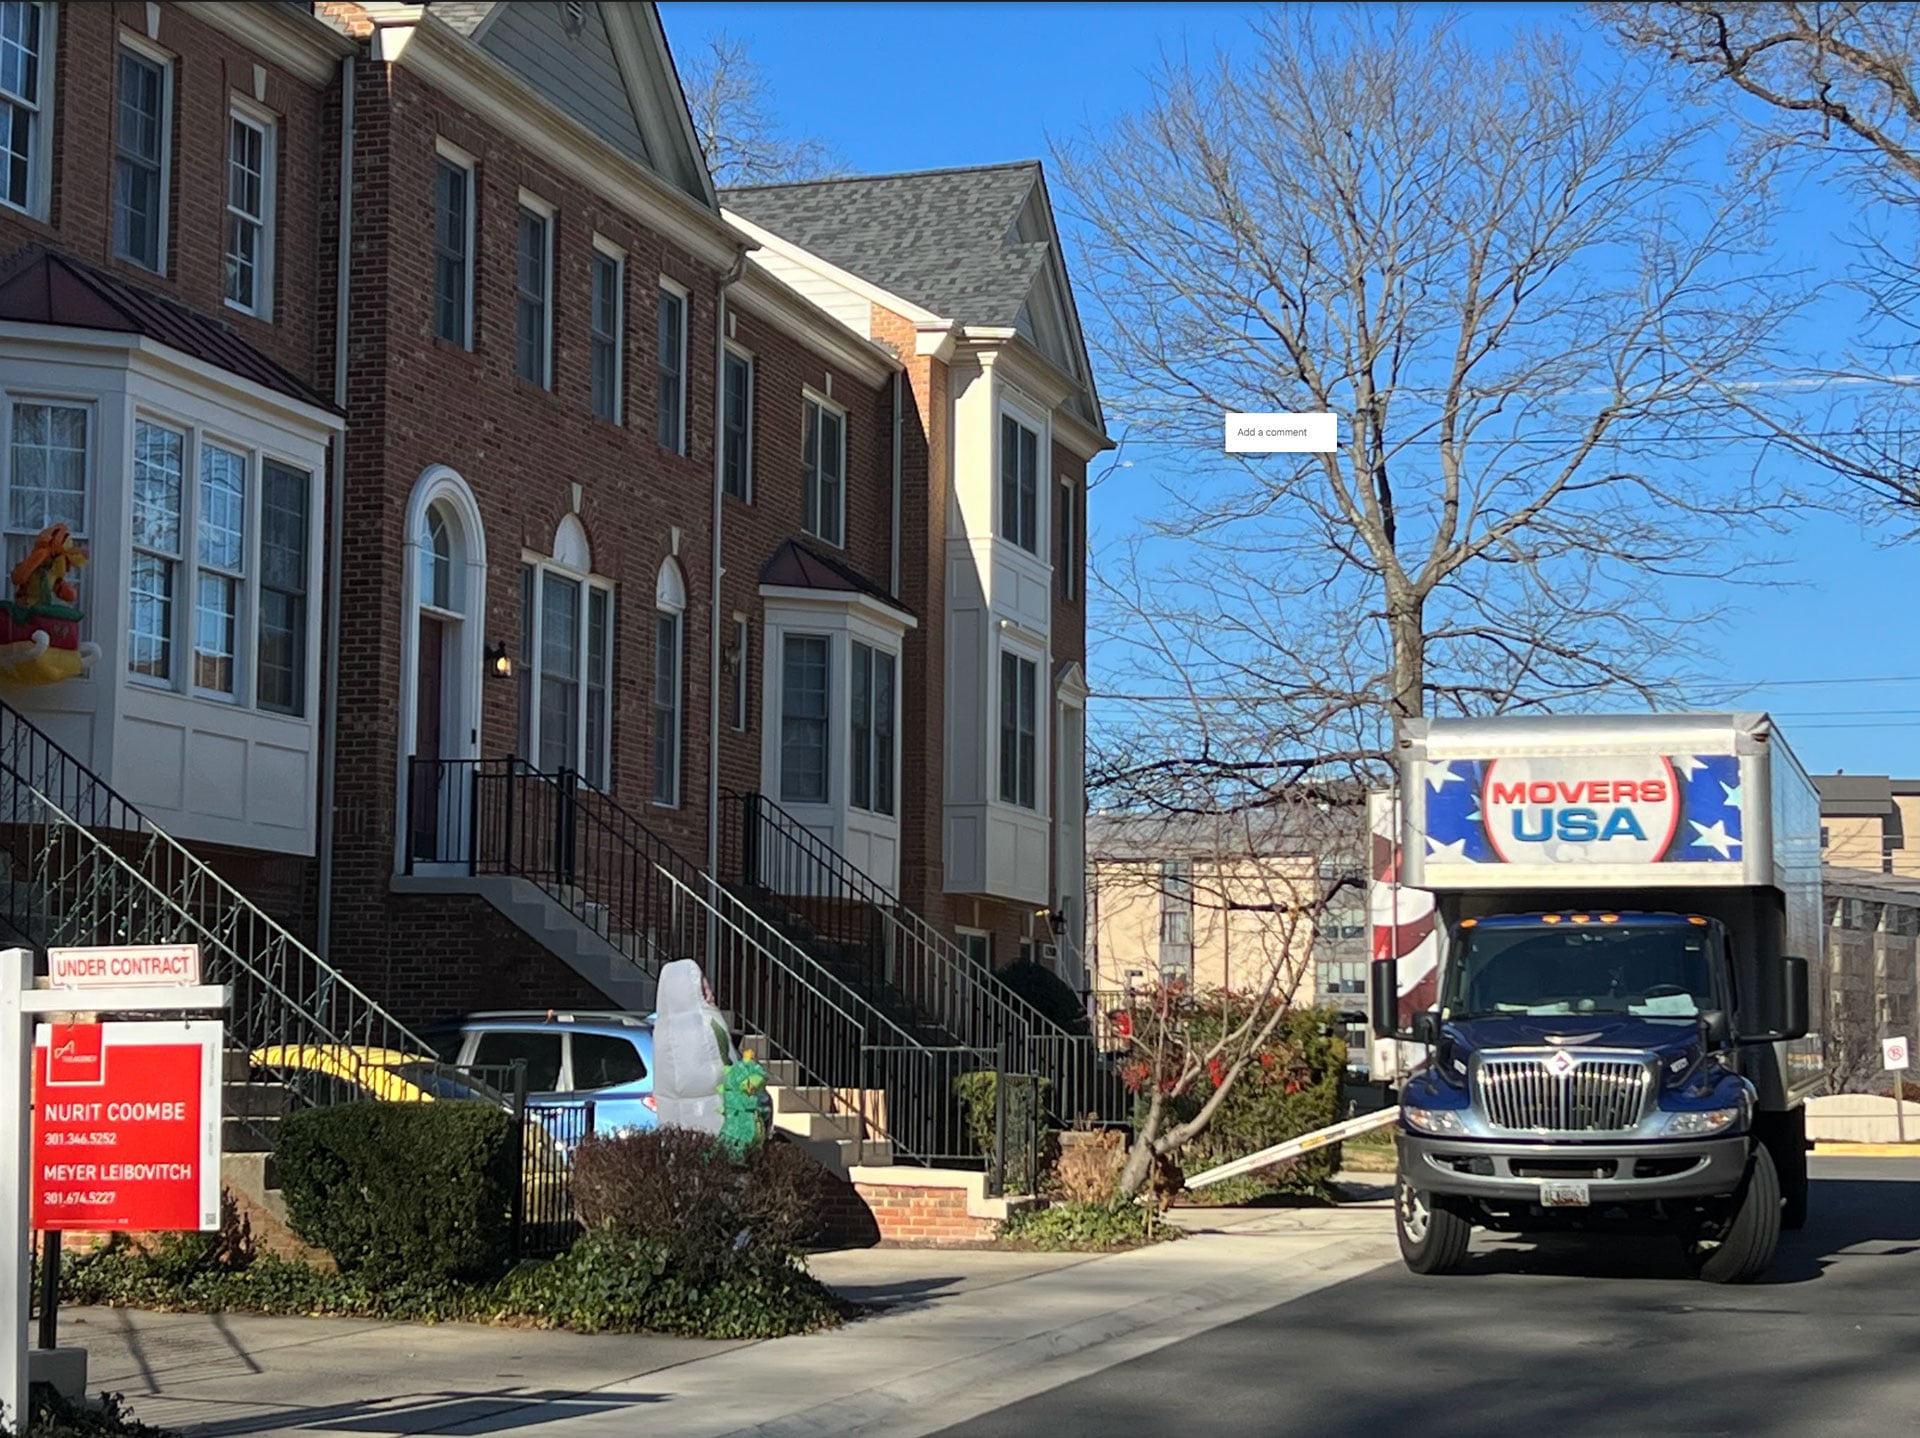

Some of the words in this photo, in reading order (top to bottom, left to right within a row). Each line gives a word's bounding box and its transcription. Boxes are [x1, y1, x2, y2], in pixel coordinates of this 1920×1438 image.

[1492, 780, 1667, 804] MOVERS
[1512, 807, 1648, 842] USA
[57, 959, 107, 977] UNDER
[111, 956, 190, 976] CONTRACT
[44, 1103, 102, 1121] NURIT
[107, 1102, 186, 1121] COOMBE
[44, 1132, 117, 1145] 301.346.5252
[44, 1164, 97, 1181] MEYER
[100, 1163, 192, 1180] LEIBOVITCH
[43, 1191, 116, 1205] 301.674.5227
